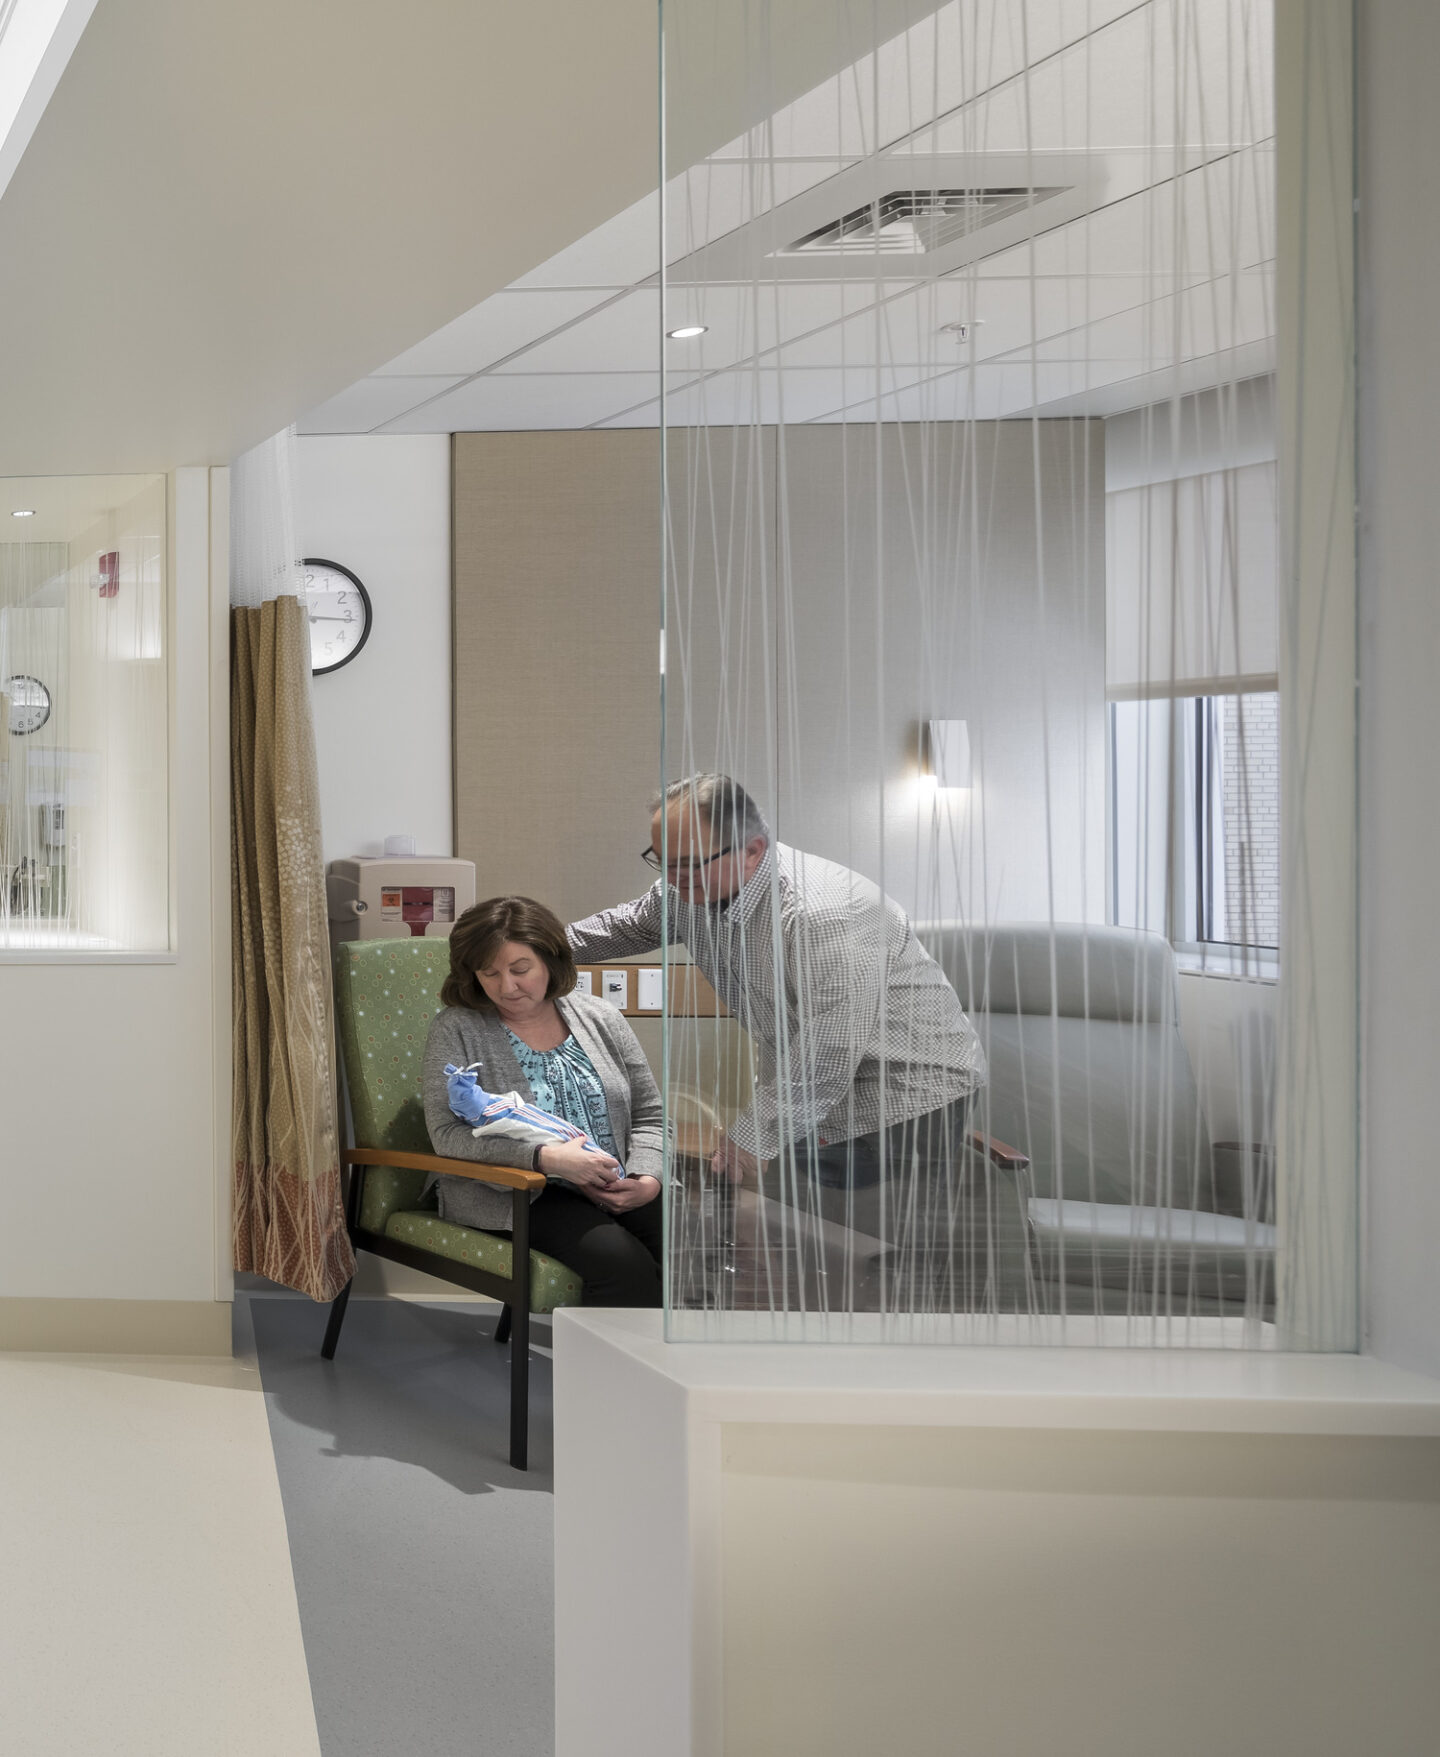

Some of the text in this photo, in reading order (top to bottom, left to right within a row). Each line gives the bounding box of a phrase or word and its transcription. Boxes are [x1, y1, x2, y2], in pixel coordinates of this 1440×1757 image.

[323, 578, 329, 591] 1
[337, 590, 348, 604] 2
[343, 609, 352, 624] 3
[336, 630, 347, 643] 4
[324, 641, 333, 656] 5
